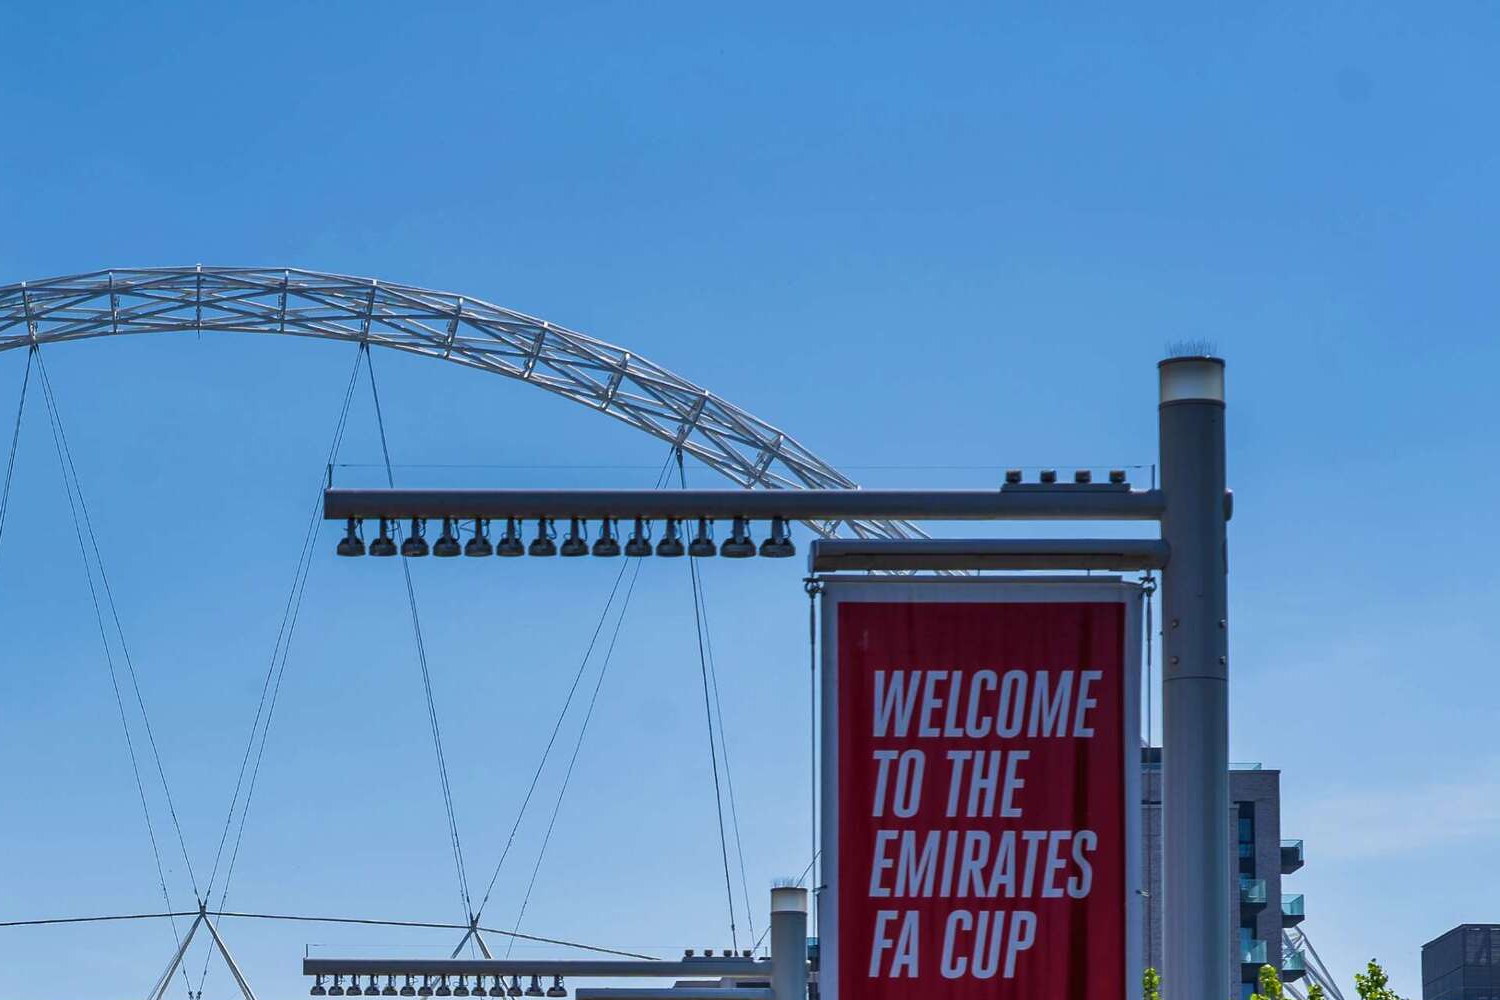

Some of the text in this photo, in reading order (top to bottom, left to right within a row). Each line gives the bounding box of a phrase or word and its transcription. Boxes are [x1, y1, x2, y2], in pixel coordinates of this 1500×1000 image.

[872, 670, 1103, 738] WELCOME
[872, 749, 1030, 818] TO THE
[868, 830, 1097, 898] EMIRATES
[868, 910, 1038, 978] FA CUP
